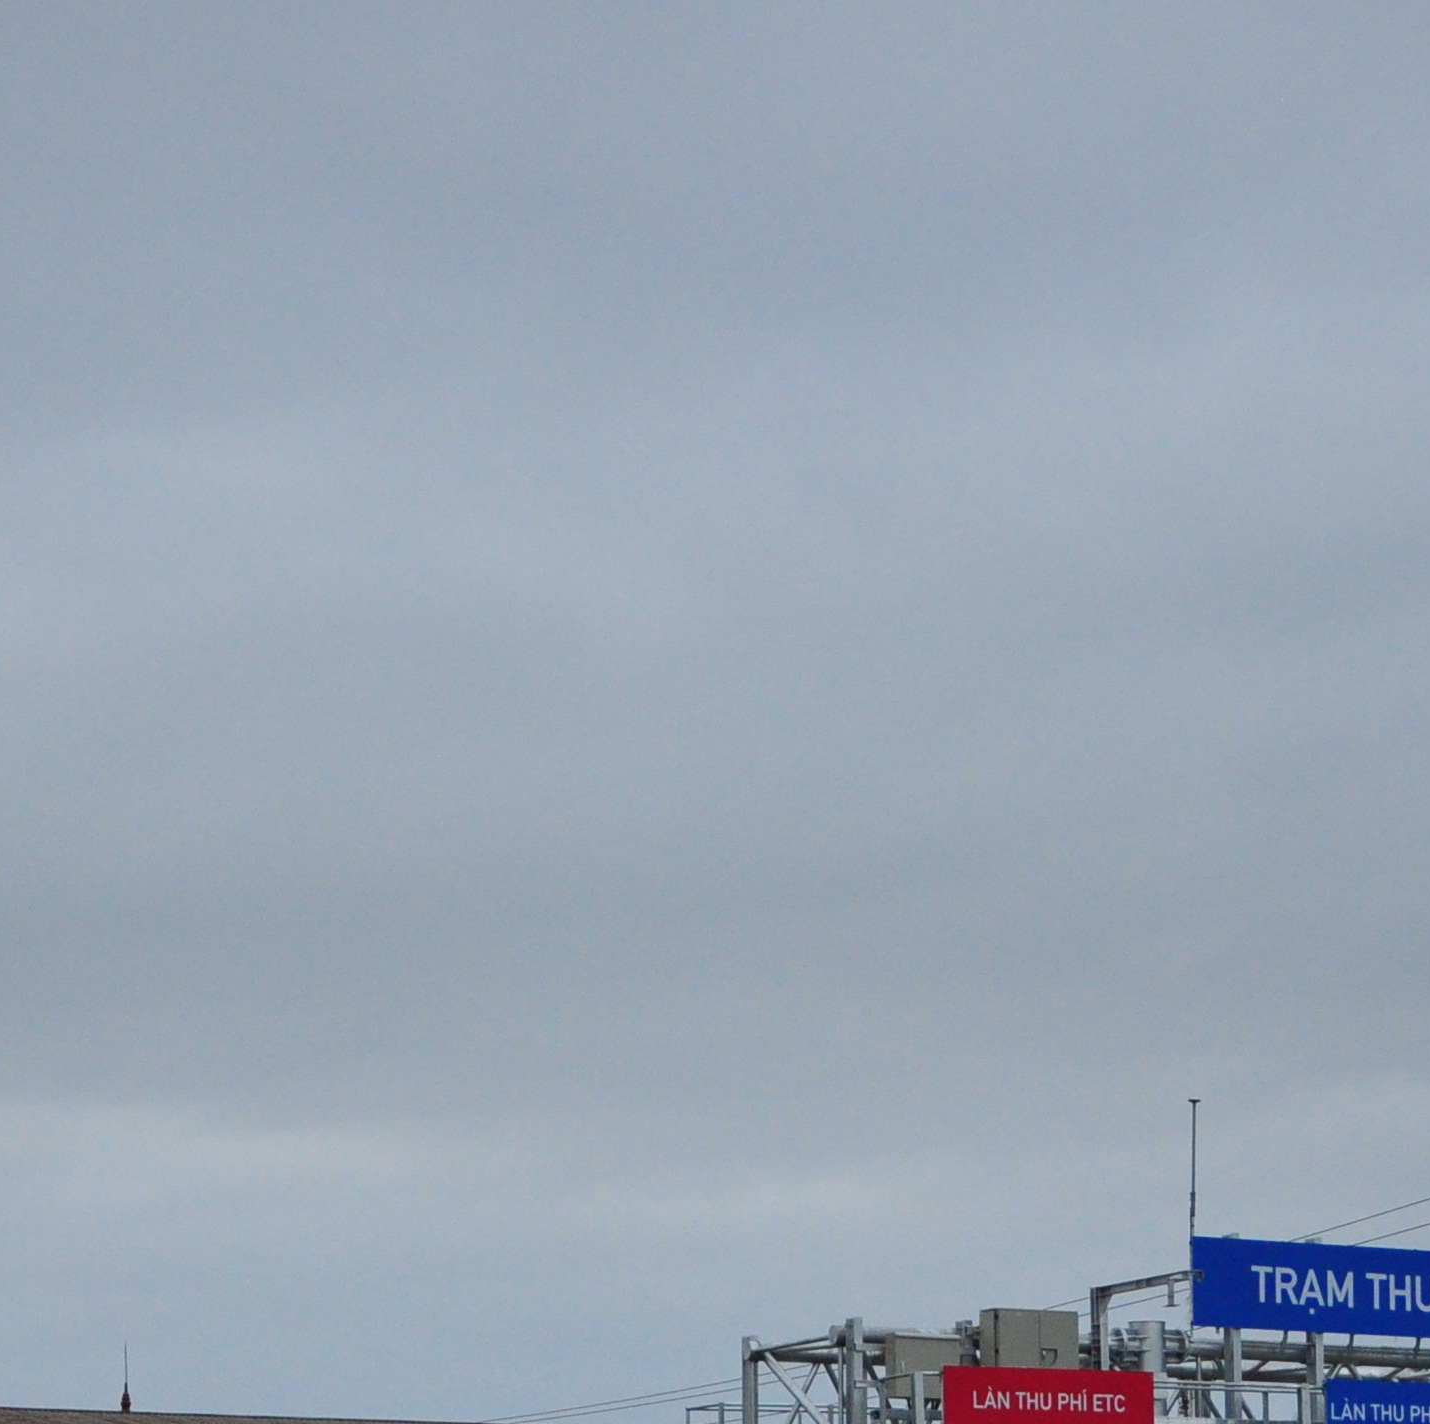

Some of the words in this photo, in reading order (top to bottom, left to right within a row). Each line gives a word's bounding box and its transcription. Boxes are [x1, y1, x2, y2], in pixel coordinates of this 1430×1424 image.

[1251, 1265, 1355, 1315] TRẠM
[973, 1386, 1009, 1409] LÀN
[1015, 1391, 1052, 1411] THU
[1058, 1389, 1087, 1411] PHÍ
[1093, 1394, 1126, 1412] ETC
[1330, 1397, 1366, 1421] LÀN
[1370, 1403, 1405, 1422] THU
